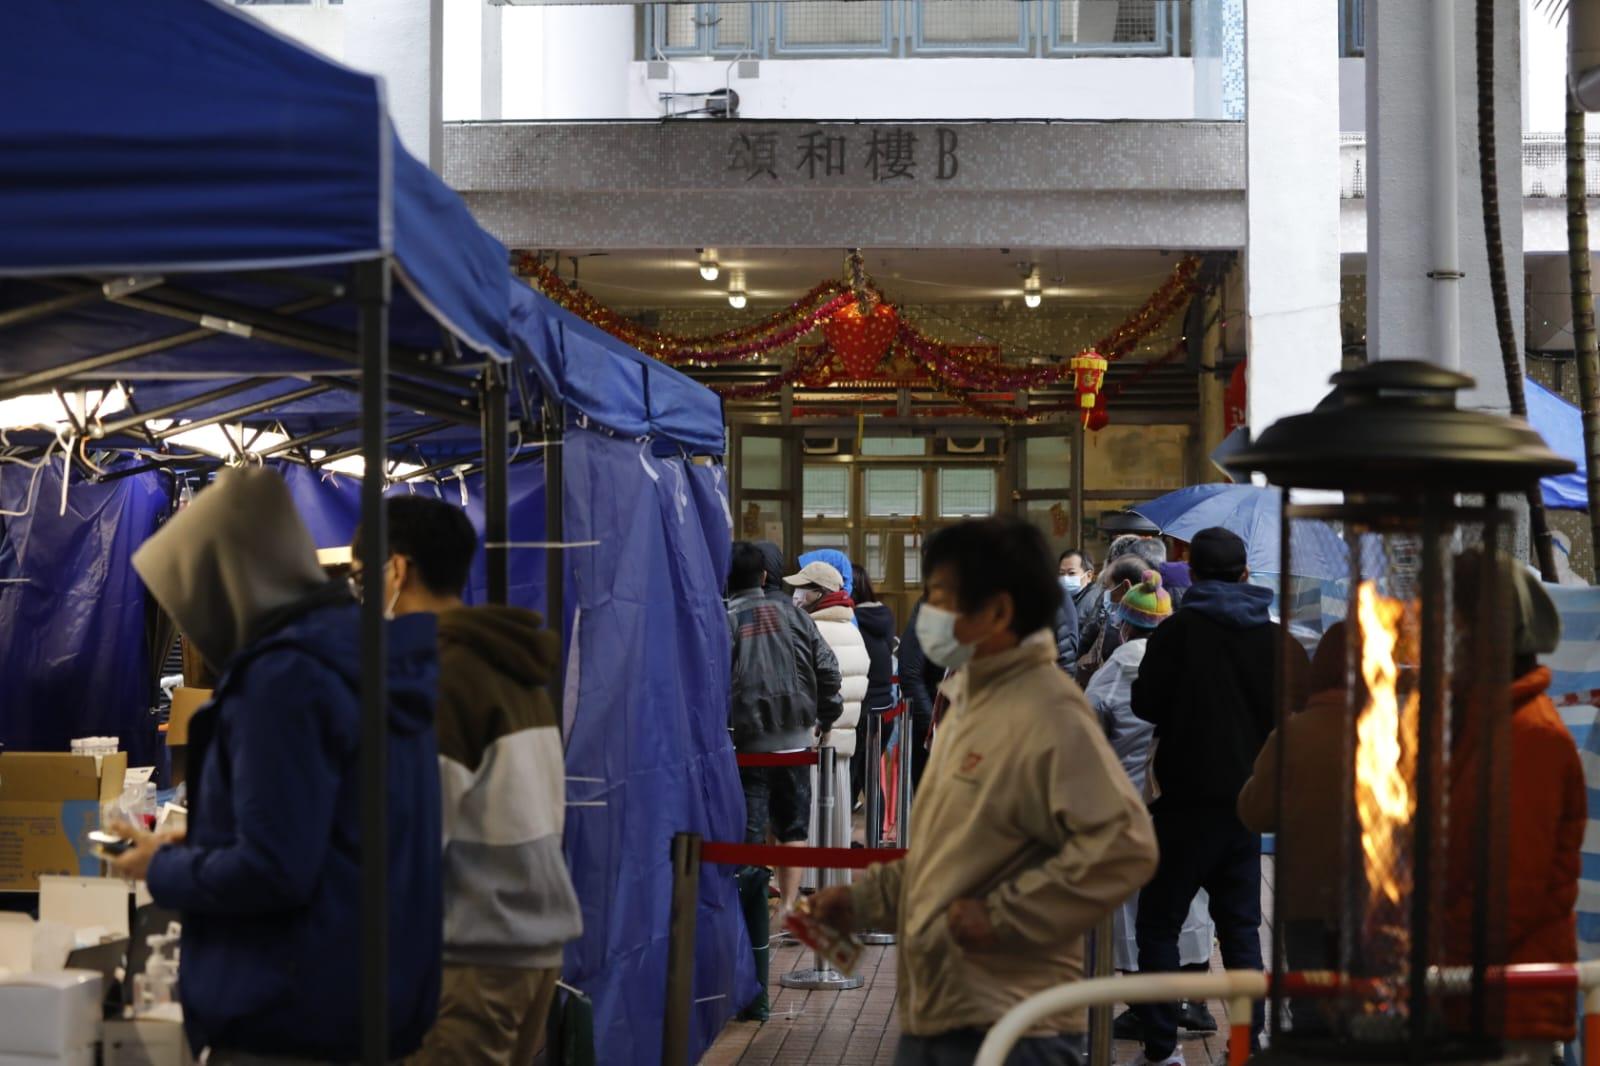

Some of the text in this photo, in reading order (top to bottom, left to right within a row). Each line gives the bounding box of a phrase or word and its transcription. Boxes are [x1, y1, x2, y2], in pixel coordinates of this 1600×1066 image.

[727, 127, 959, 182] 頌和樓 B
